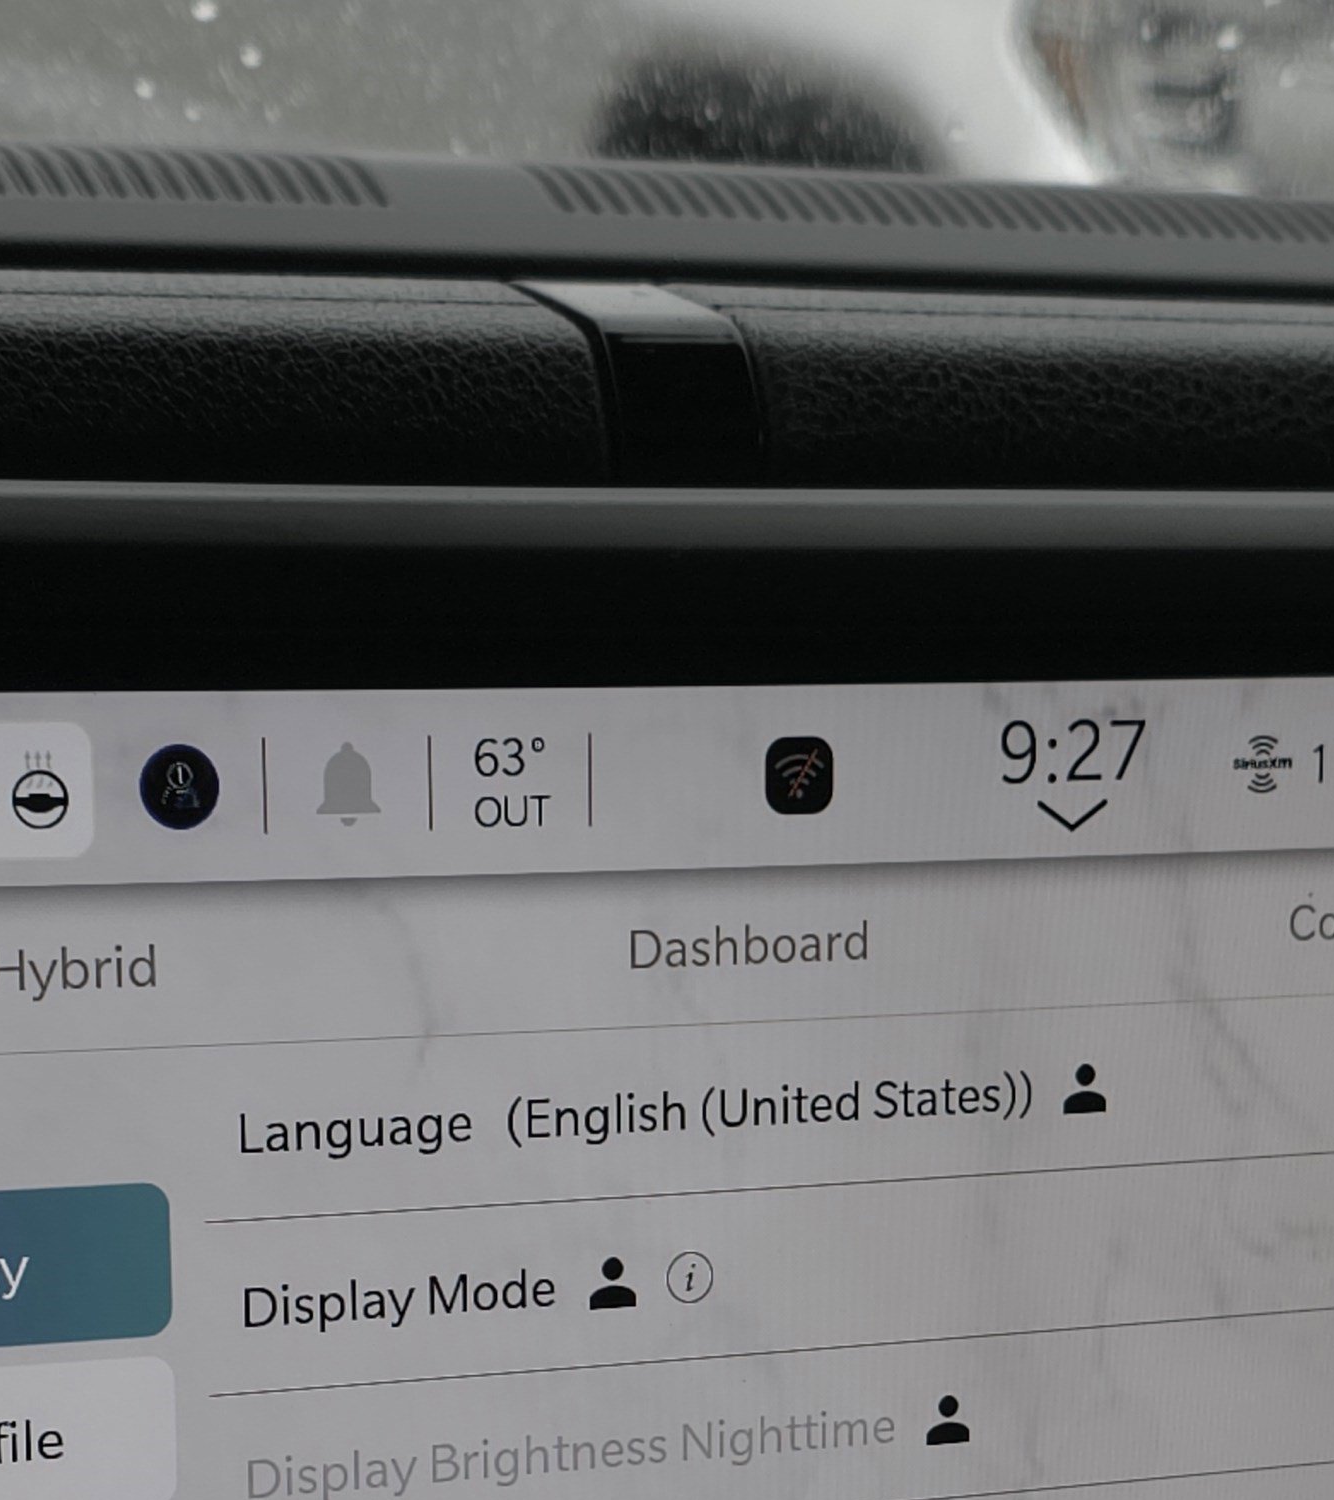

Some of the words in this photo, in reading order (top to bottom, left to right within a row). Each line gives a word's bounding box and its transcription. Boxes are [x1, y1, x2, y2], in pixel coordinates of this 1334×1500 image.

[474, 736, 545, 777] 63°
[1001, 718, 1146, 785] 9:27
[1314, 744, 1324, 783] 1
[474, 794, 551, 828] OUT
[630, 919, 868, 969] Dashboard
[240, 1113, 472, 1160] Language
[507, 1090, 686, 1148] (English
[702, 1080, 859, 1135] (United
[873, 1070, 1032, 1121] States))
[244, 1278, 416, 1333] Display
[428, 1268, 555, 1315] Mode
[431, 1434, 667, 1487] Brightness
[682, 1410, 895, 1467] Nighttime
